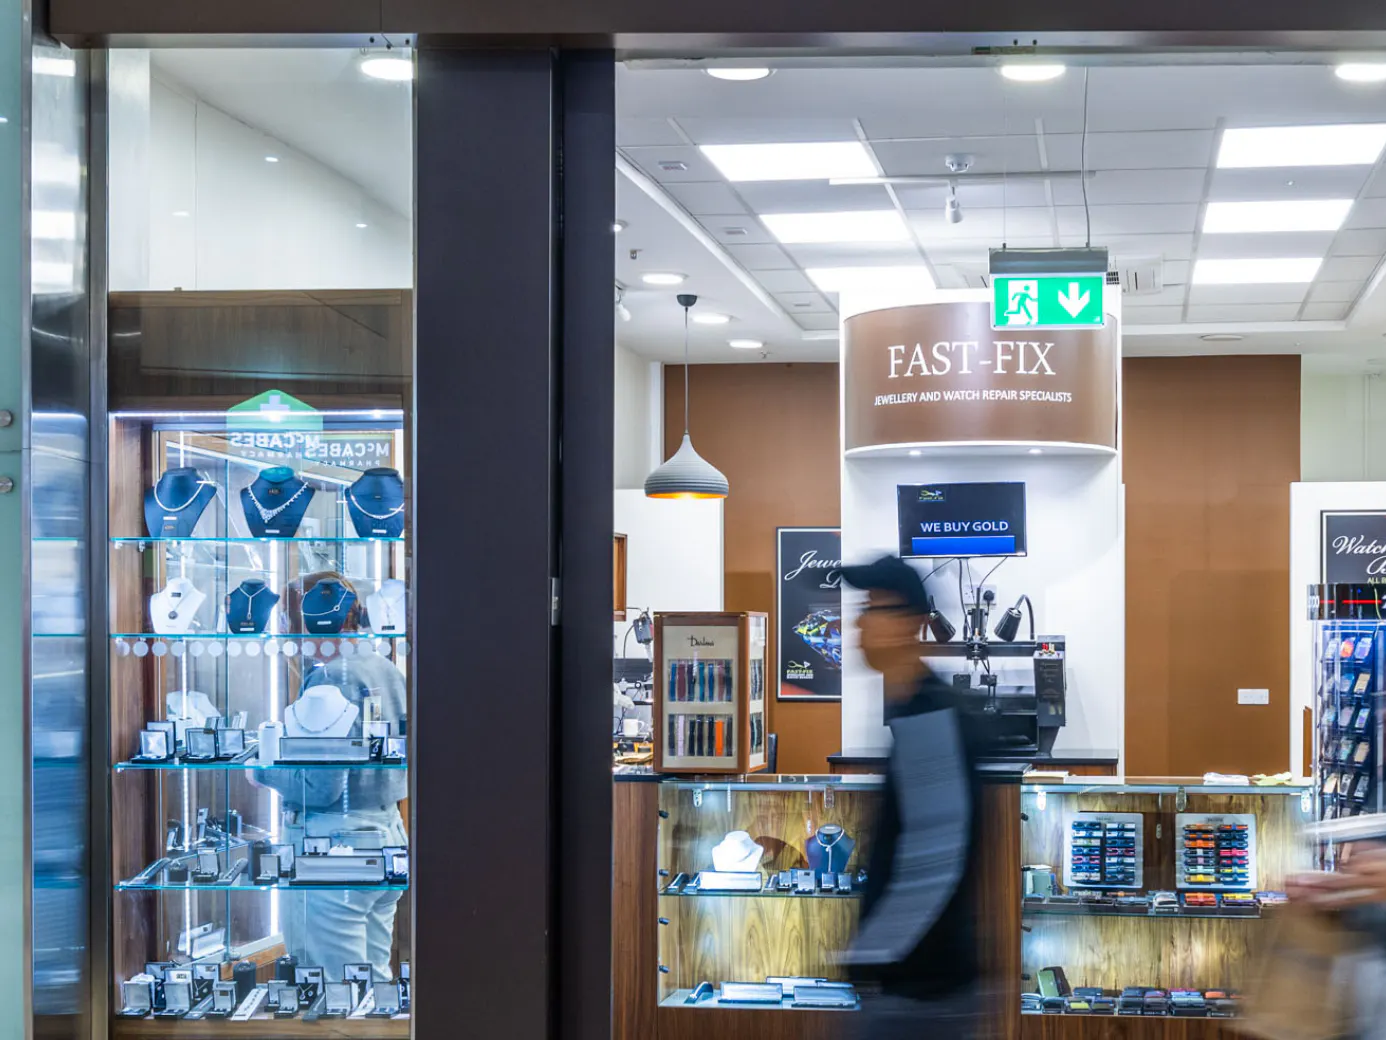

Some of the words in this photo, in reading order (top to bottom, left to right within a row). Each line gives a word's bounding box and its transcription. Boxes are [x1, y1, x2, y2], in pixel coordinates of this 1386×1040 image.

[888, 341, 1056, 378] FAST-FIX
[874, 391, 917, 406] JEWELLERY
[919, 391, 941, 402] AND
[944, 389, 980, 401] WATCH
[982, 390, 1018, 401] REPAIR
[1019, 390, 1072, 403] SPECIALISTS
[920, 522, 941, 533] WE
[944, 521, 970, 532] BUY
[972, 521, 1009, 532] GOLD
